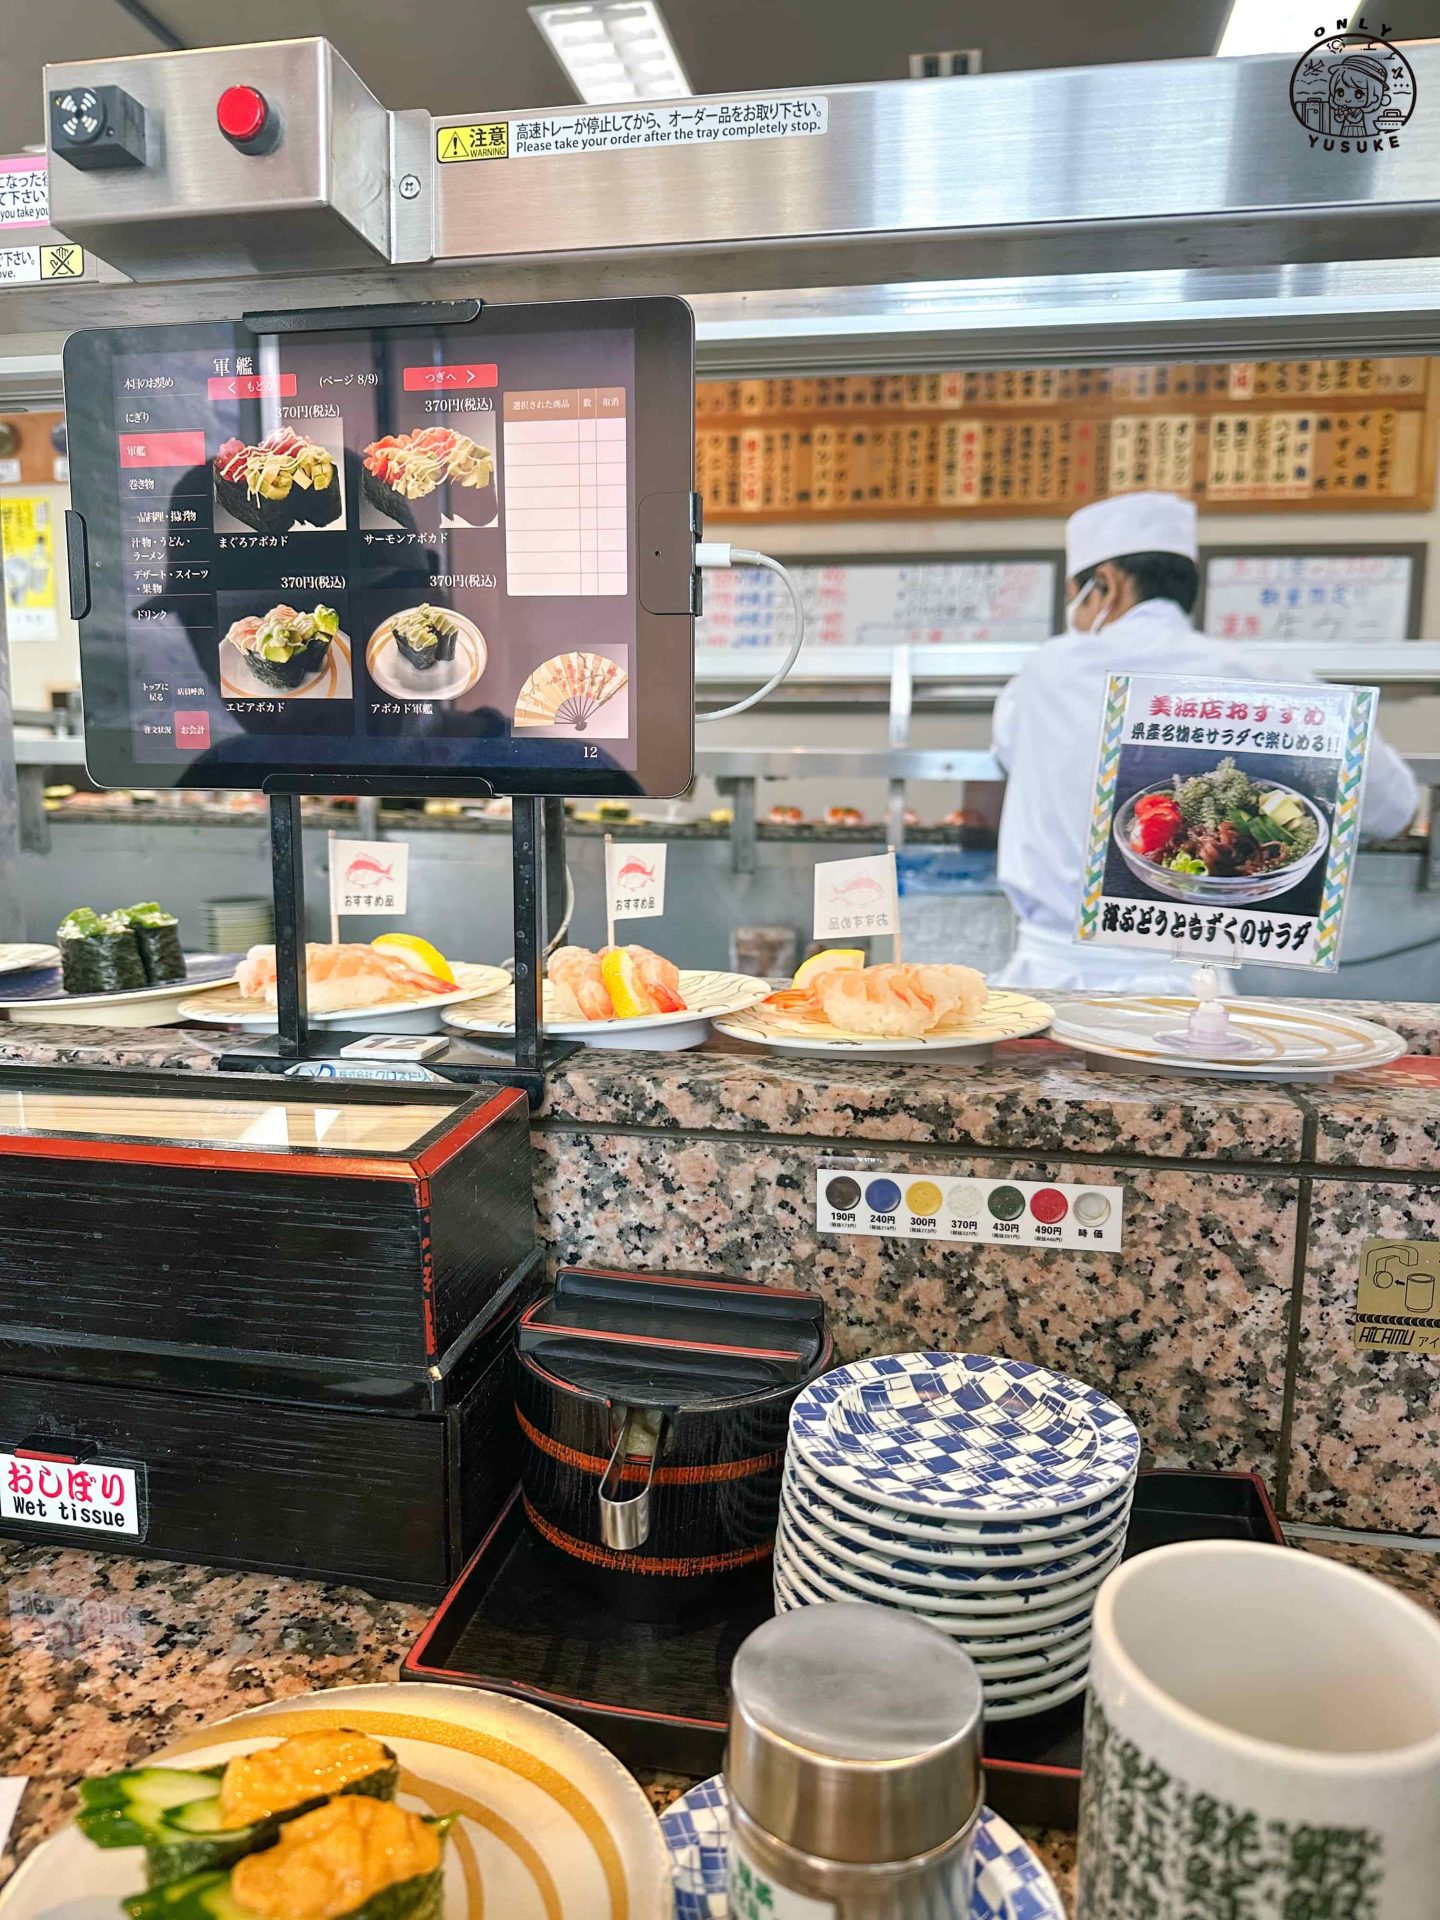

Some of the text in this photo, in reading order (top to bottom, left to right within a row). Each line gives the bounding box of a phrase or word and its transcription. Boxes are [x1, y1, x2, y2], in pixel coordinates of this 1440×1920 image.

[469, 126, 506, 148] 注意
[516, 120, 821, 153] Please take your order after the tray completely stop.
[470, 147, 506, 158] WARNING
[1, 208, 15, 220] you
[17, 206, 34, 218] take
[213, 356, 254, 377] 軍艦
[425, 371, 457, 384] つぎへ
[425, 397, 493, 412] 370円(税込)
[125, 411, 150, 423] にぎり
[274, 404, 340, 419] 370円(税込)
[129, 478, 155, 490] 巻き物
[218, 534, 289, 549] まぐろアボカド
[364, 532, 449, 546] サーモンアボカド
[132, 550, 166, 562] ラーメン
[281, 575, 346, 590] 370円(税込)
[429, 574, 497, 589] 370円(税込)
[137, 609, 167, 621] ドリンク
[143, 682, 169, 692] トップに
[149, 693, 164, 702] 戻る
[225, 702, 286, 714] エビアボカド
[370, 703, 434, 715] アボカド軍艦
[1149, 694, 1325, 727] 美浜店おすすめ
[180, 725, 205, 735] お会計
[583, 746, 598, 759] 12
[344, 894, 395, 907] おすすめ品
[615, 896, 655, 911] おすすめ品
[364, 1037, 427, 1050] 12
[831, 1211, 856, 1222] 190円
[870, 1214, 897, 1225] 240円
[910, 1217, 937, 1228] 300円
[951, 1219, 978, 1230] 370円
[992, 1222, 1020, 1233] 430円
[1034, 1225, 1062, 1236] 490円
[1078, 1228, 1103, 1239] 時価
[8, 1461, 125, 1507] おしぼり
[13, 1496, 125, 1527] Wet tissue
